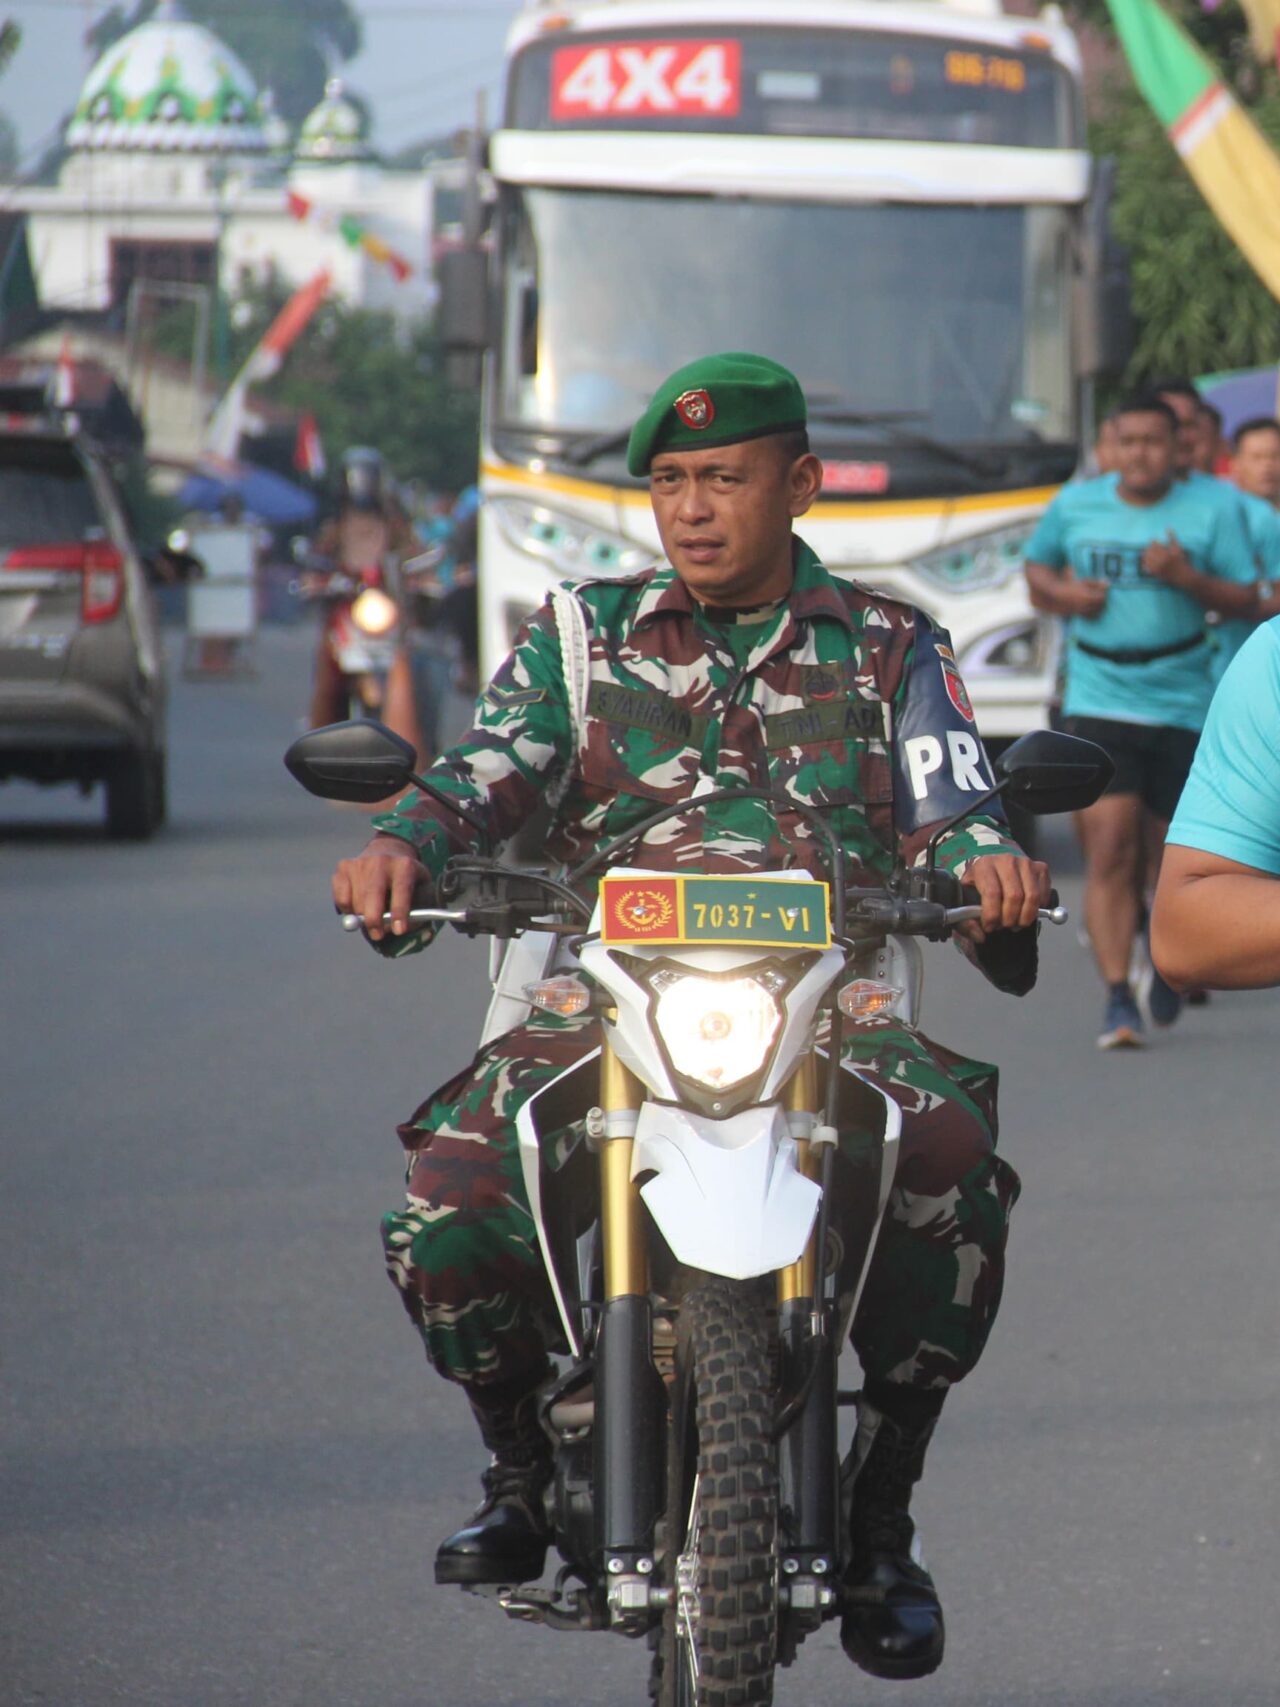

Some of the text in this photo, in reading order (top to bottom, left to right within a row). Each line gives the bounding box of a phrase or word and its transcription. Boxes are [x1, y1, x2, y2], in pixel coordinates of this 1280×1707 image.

[560, 45, 732, 111] 4X4
[776, 712, 822, 739] TNI
[843, 705, 876, 732] AD
[904, 730, 997, 800] PR
